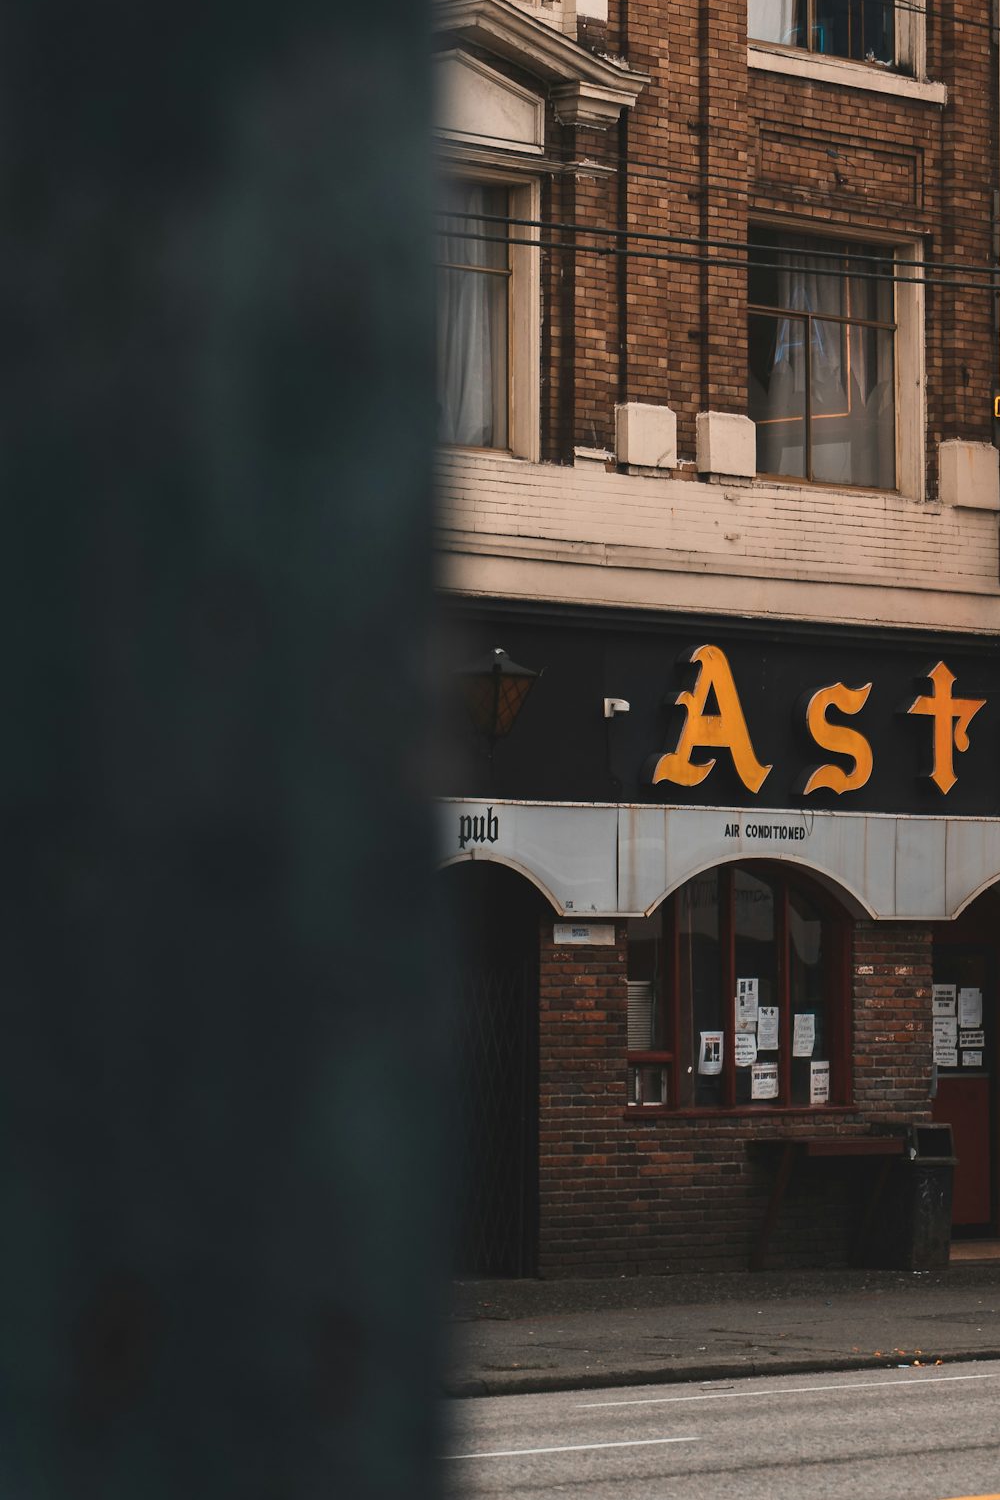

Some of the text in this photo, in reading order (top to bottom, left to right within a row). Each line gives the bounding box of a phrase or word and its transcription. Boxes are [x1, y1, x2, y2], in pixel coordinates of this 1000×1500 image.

[458, 807, 499, 849] pub
[724, 823, 805, 841] AIR CONDITIONED
